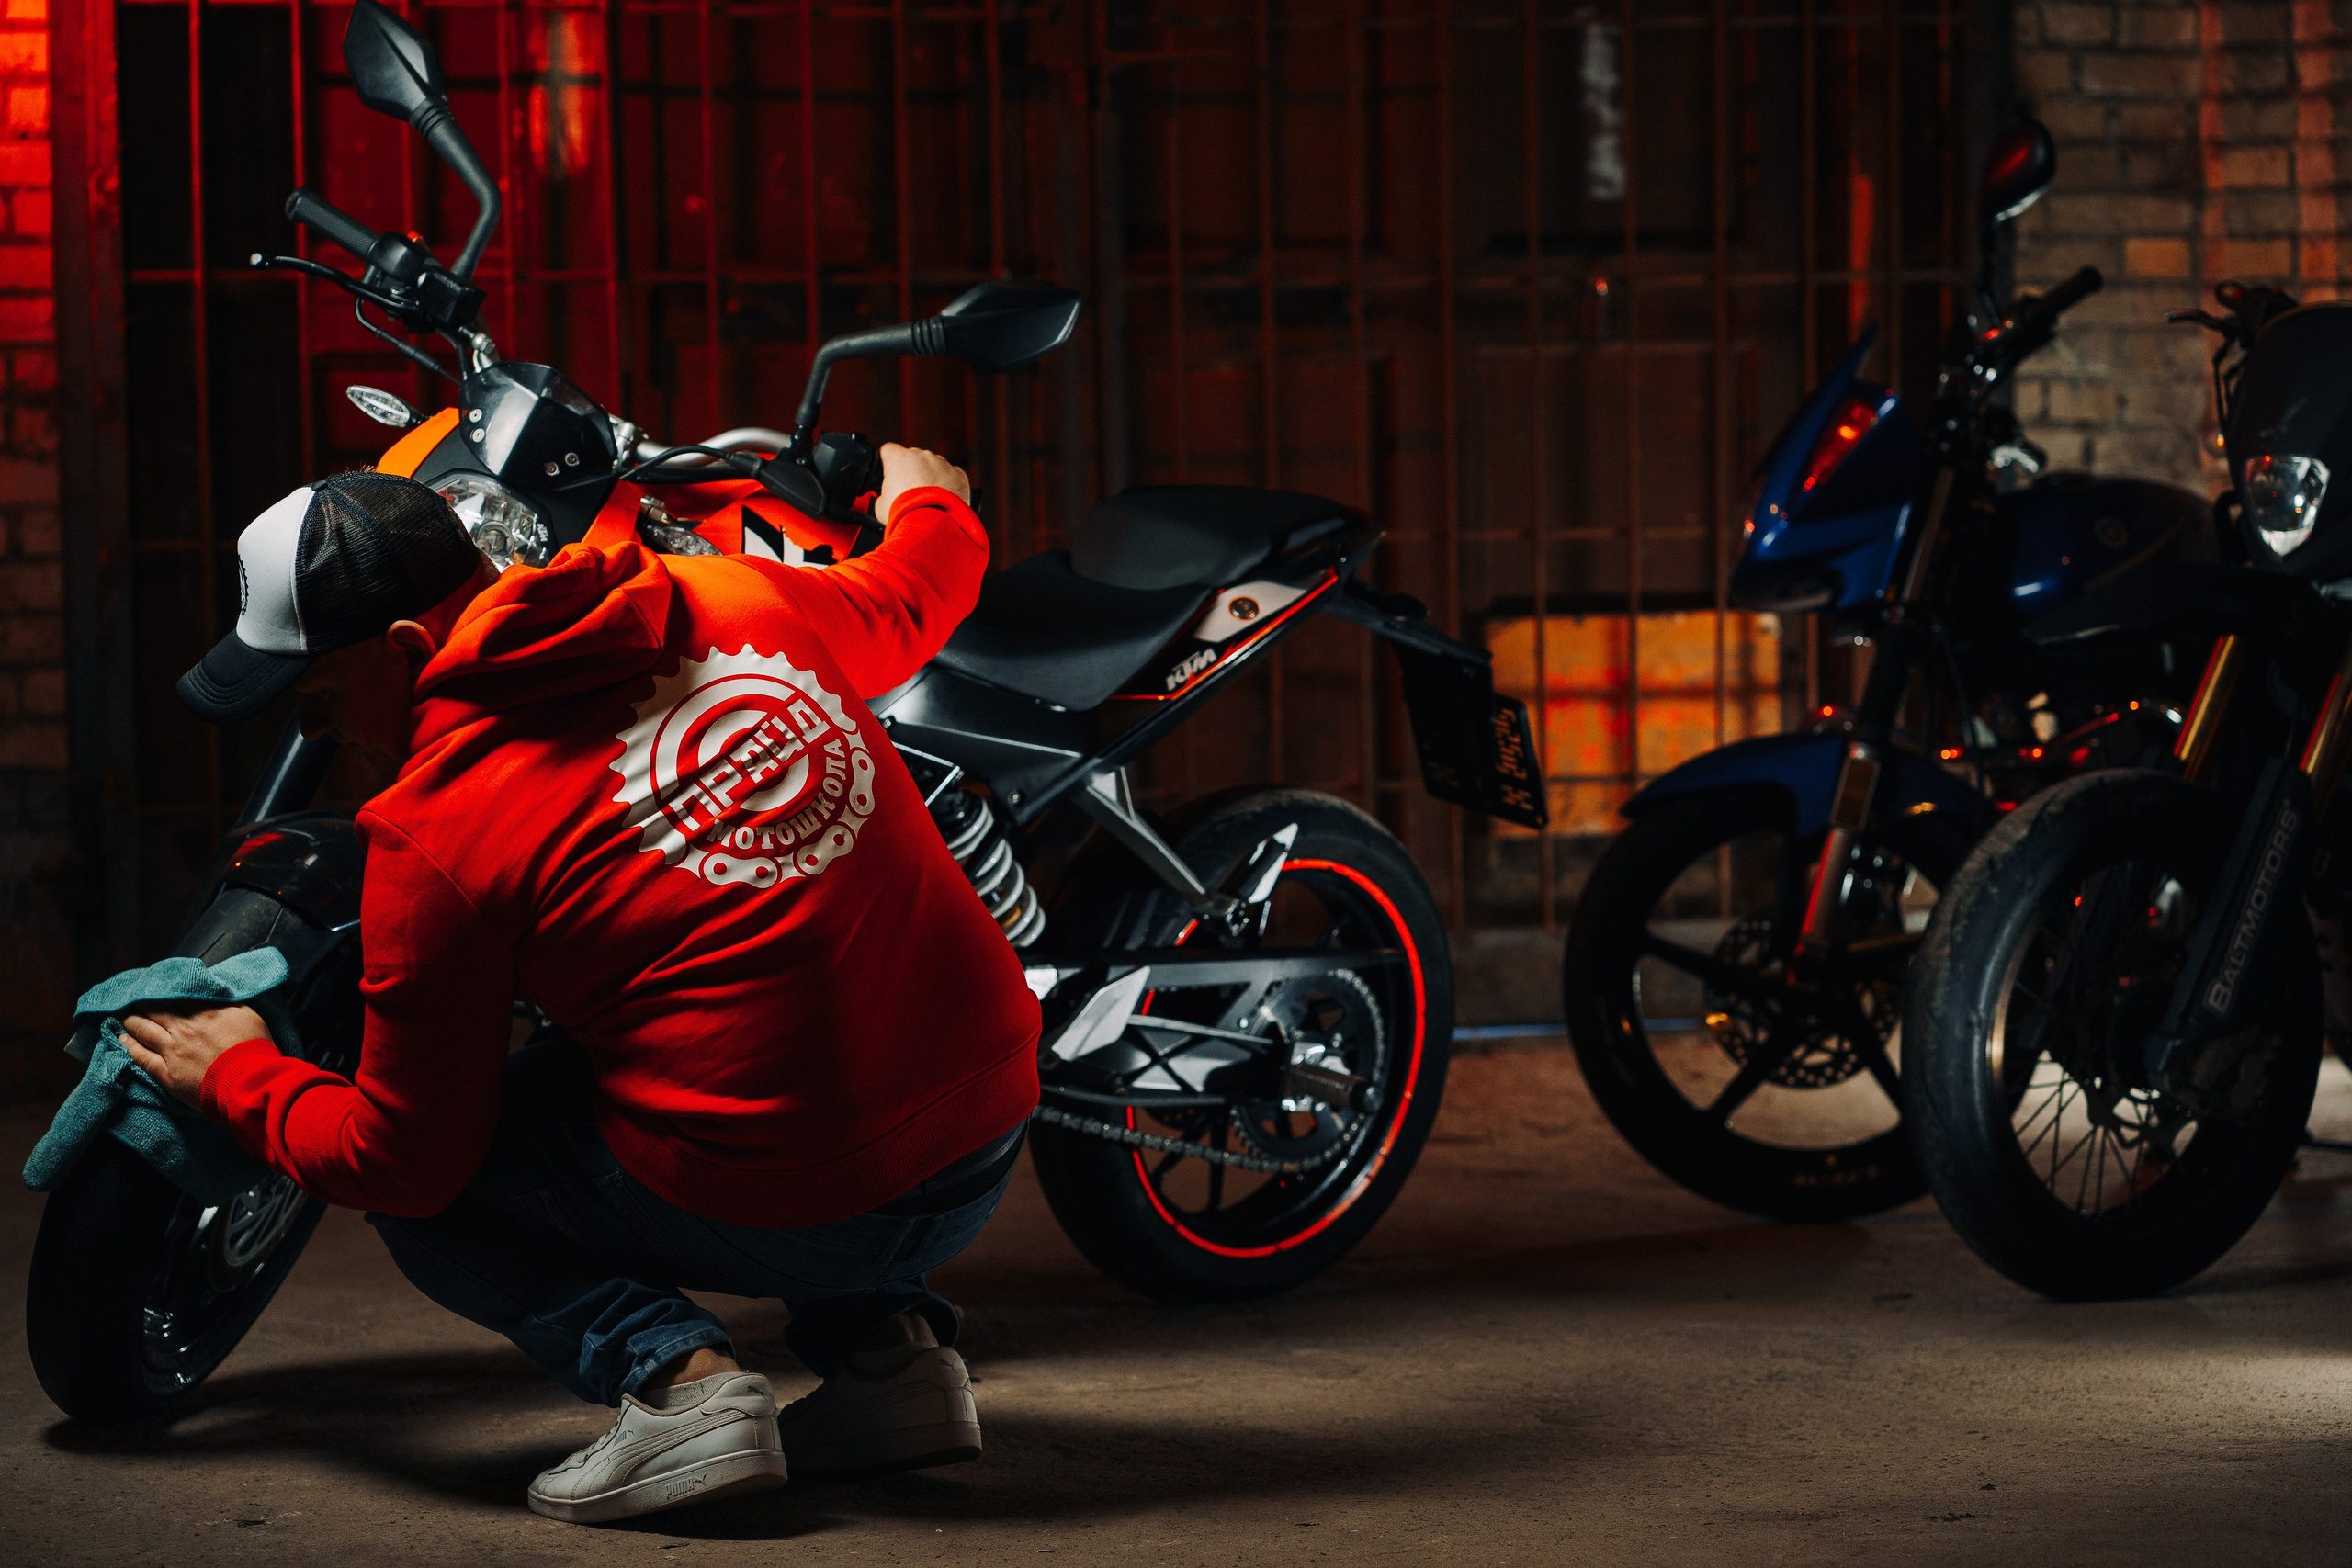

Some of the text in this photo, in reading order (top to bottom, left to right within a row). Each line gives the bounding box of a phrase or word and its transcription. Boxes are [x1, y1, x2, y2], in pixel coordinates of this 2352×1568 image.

[1165, 647, 1218, 693] KTM
[668, 698, 831, 832] ПРАЙД
[706, 739, 847, 850] МОТОШКОЛА
[664, 1477, 695, 1500] PUMA
